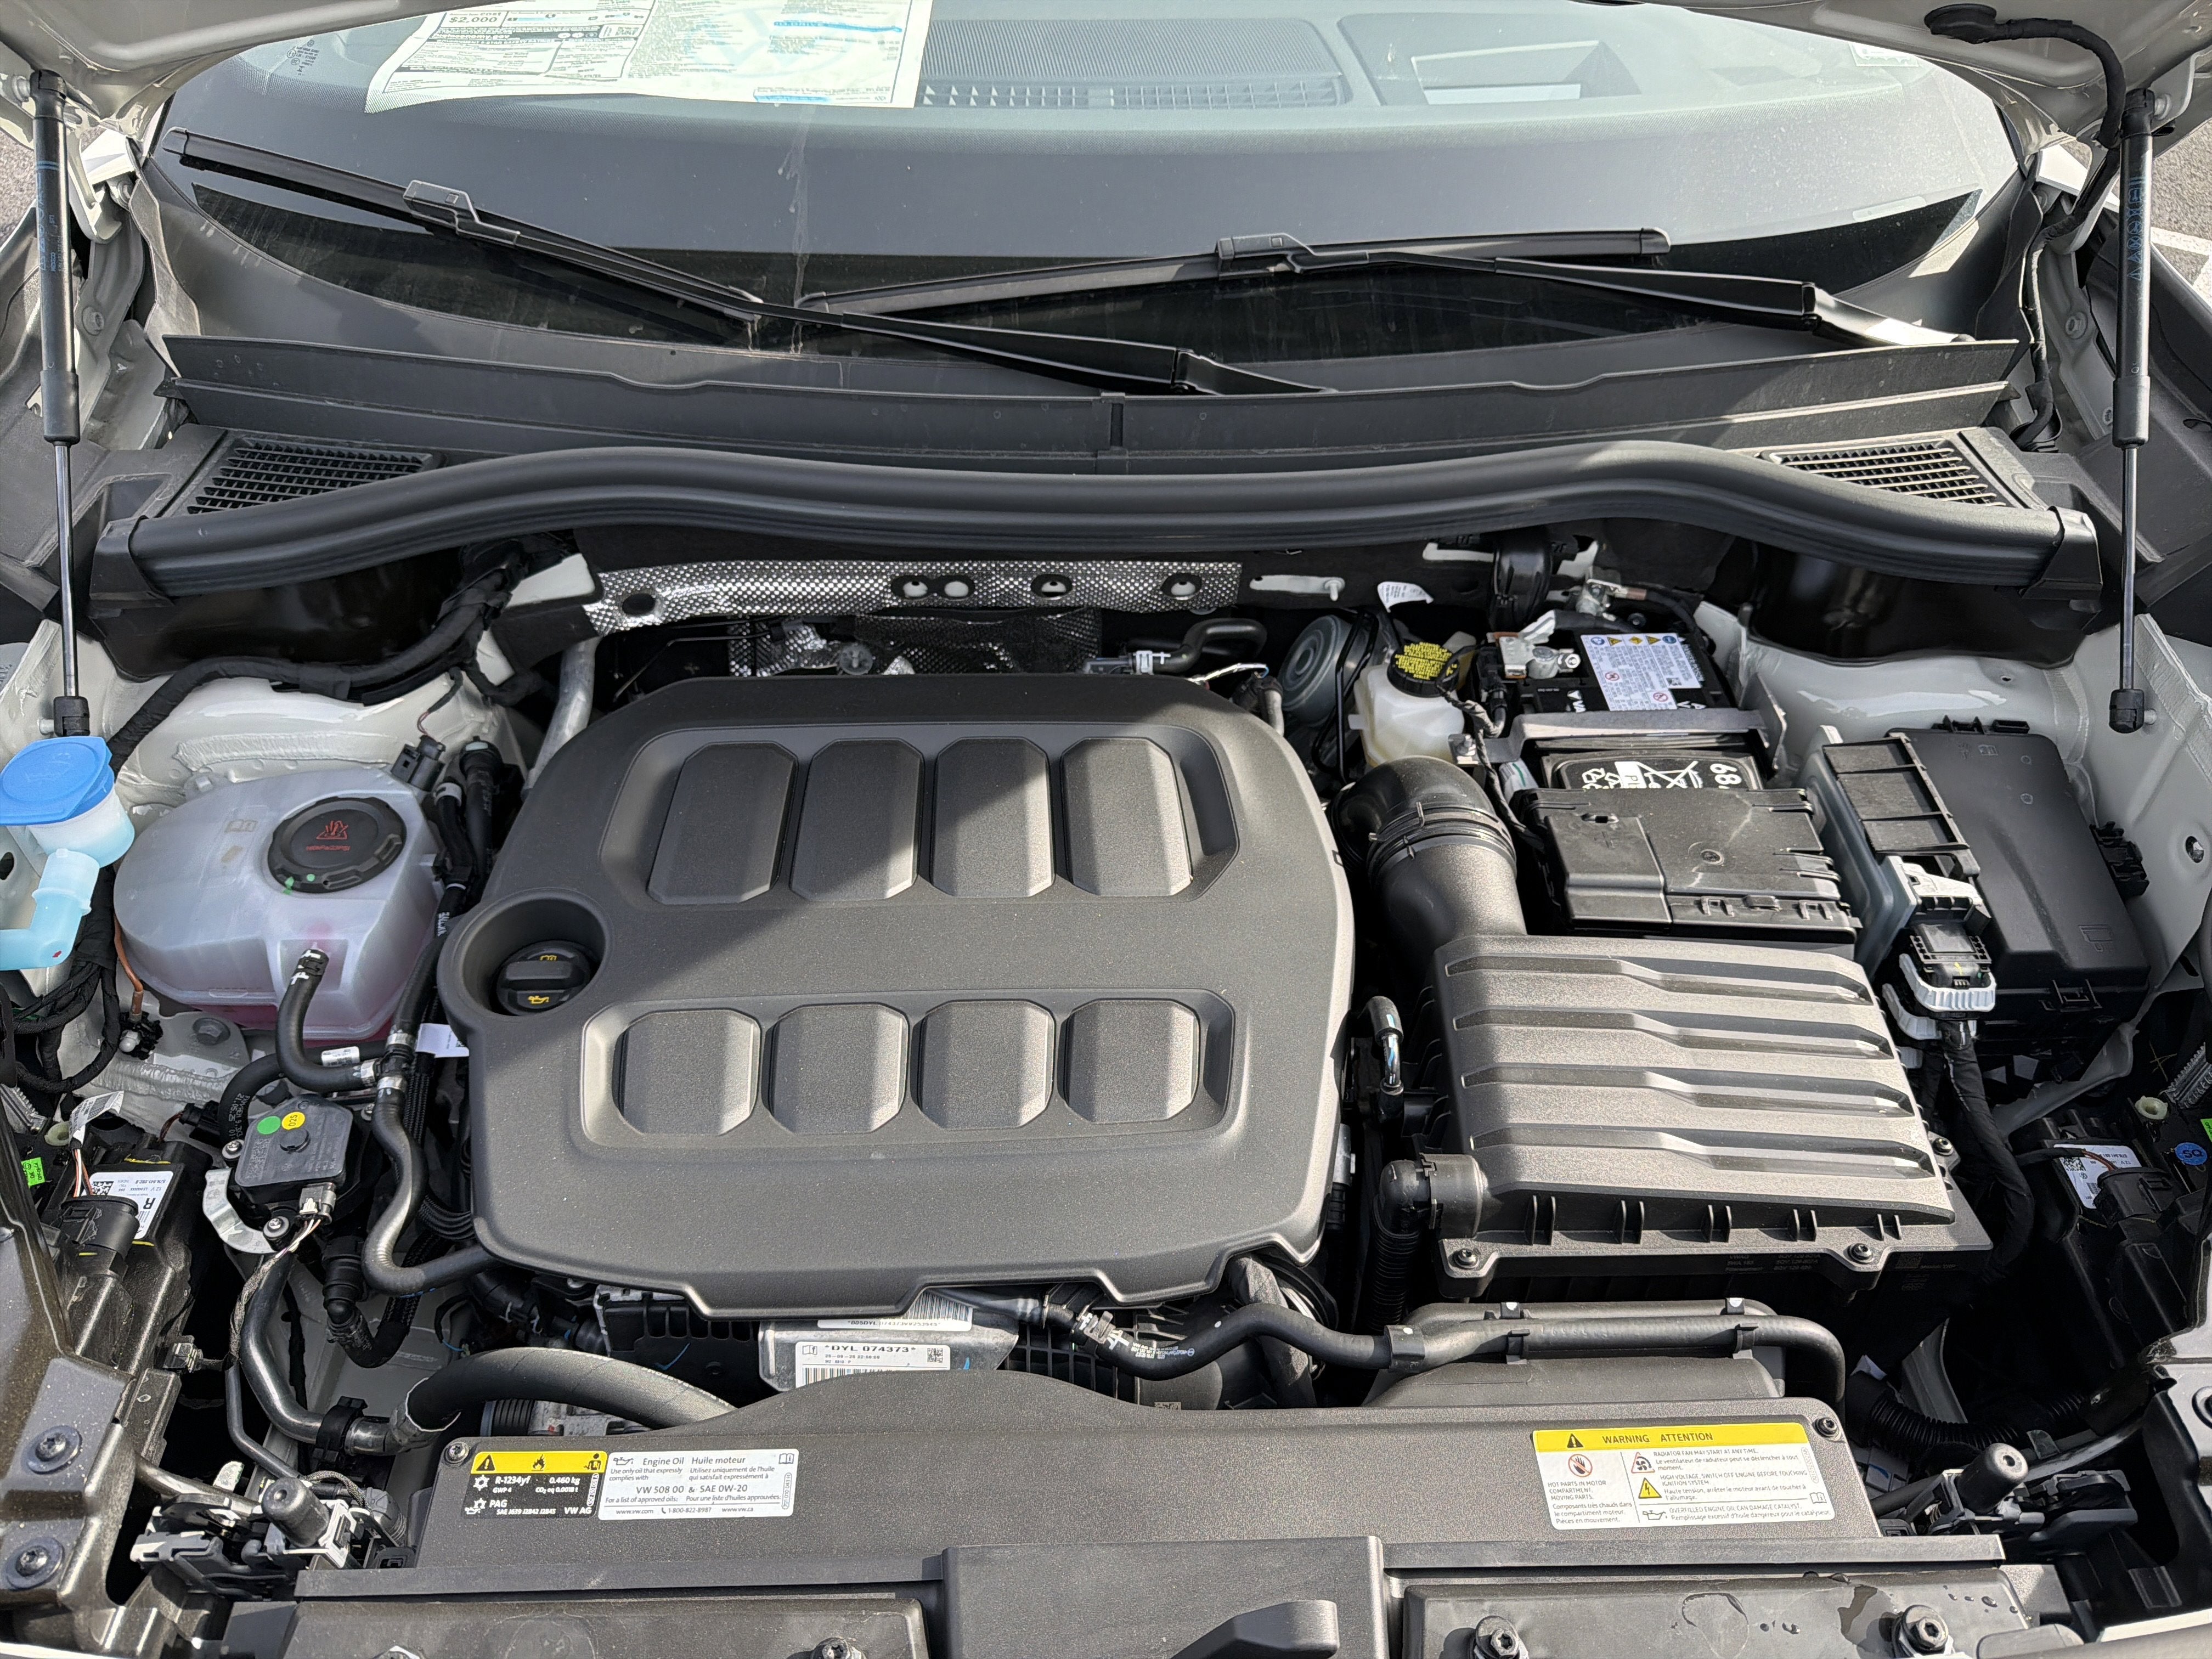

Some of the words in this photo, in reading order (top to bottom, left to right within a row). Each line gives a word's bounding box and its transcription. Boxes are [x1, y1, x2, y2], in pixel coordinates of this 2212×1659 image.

[143, 1198, 156, 1210] R
[1602, 1434, 1650, 1444] WARNING
[1661, 1432, 1713, 1442] ATTENTION
[643, 1458, 670, 1467] Engine
[495, 1476, 531, 1486] R-1234yf
[571, 1477, 580, 1486] kg
[718, 1484, 748, 1492] 0W-20
